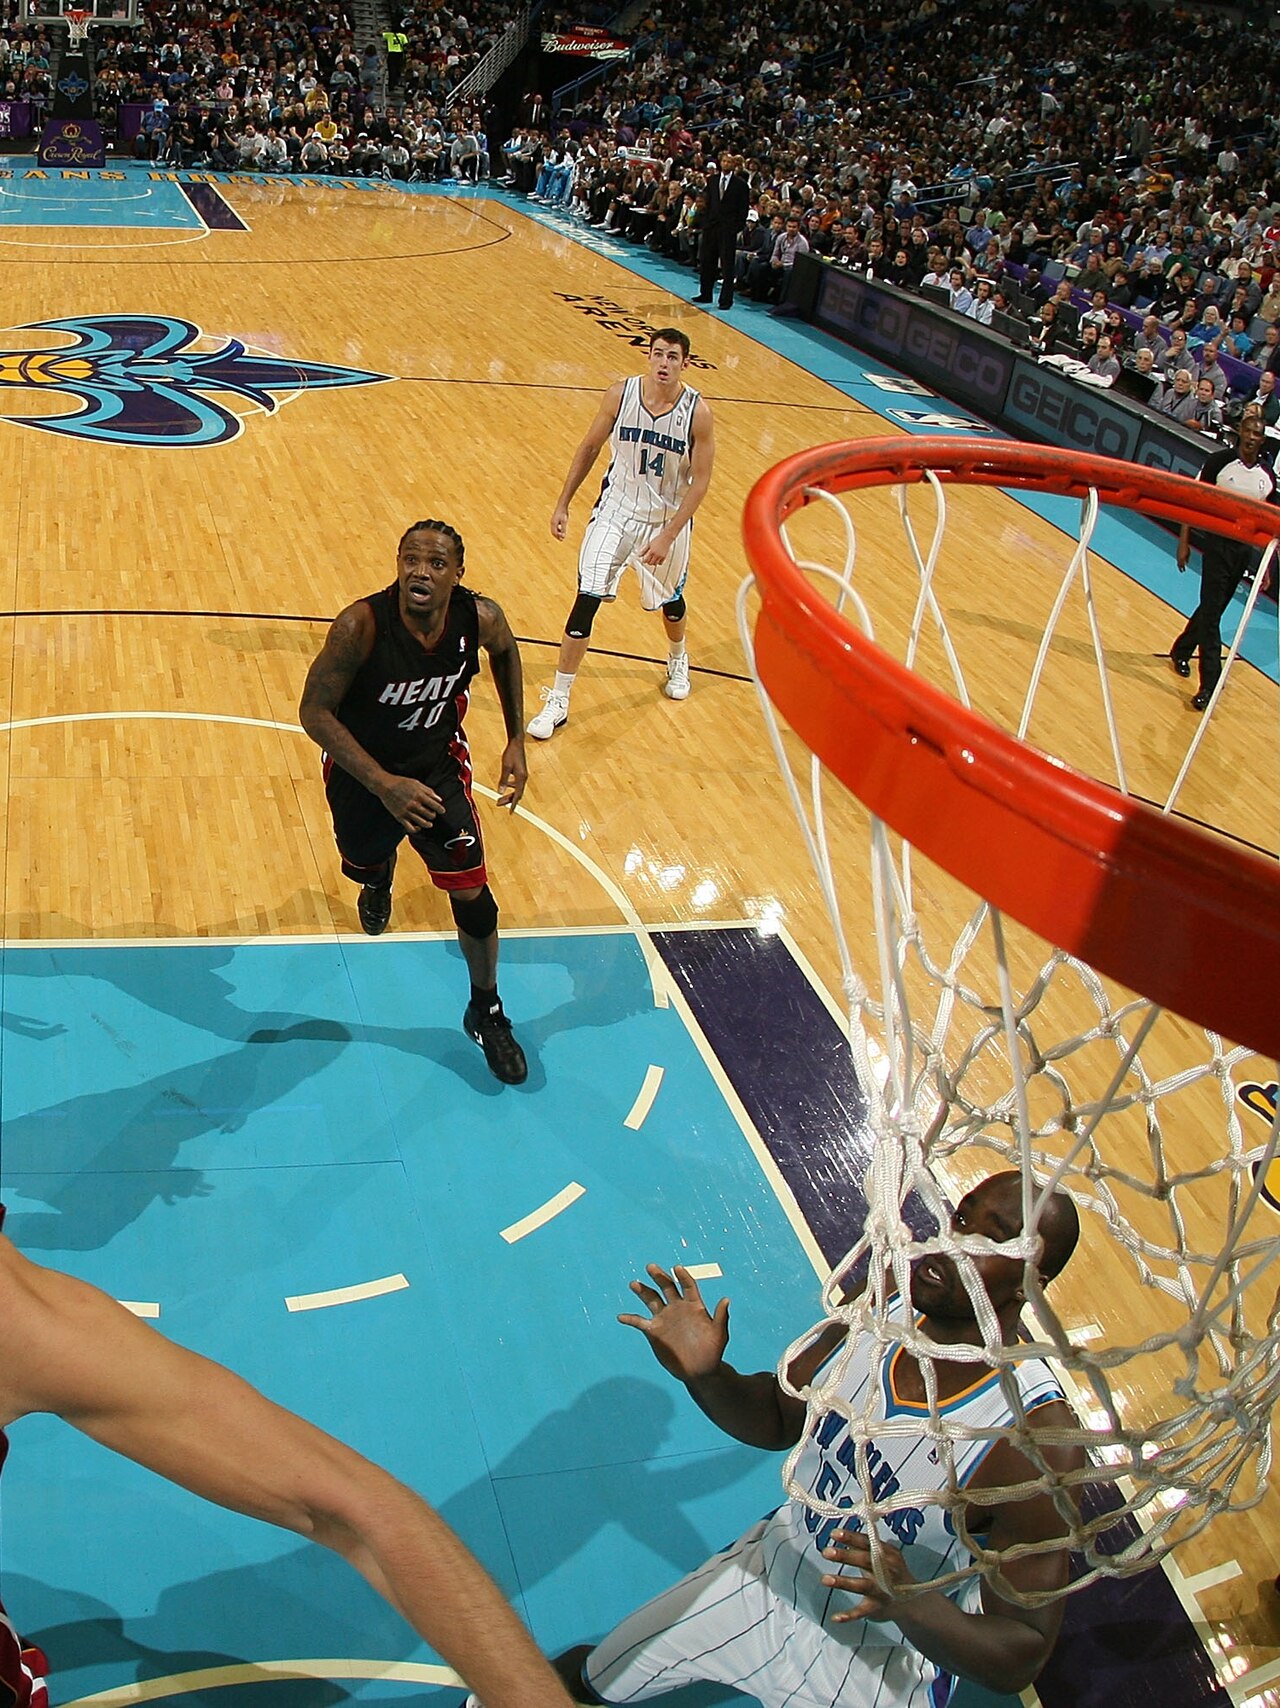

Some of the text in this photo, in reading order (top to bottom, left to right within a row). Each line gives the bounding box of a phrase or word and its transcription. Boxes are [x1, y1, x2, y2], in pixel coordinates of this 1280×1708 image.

[542, 39, 614, 53] Budweiser
[42, 146, 102, 163] Crown Royal
[148, 171, 402, 193] HORNETS
[552, 291, 651, 355] AREN
[907, 321, 1004, 395] GEICO
[1013, 373, 1128, 457] GEICO
[639, 448, 663, 477] 14
[378, 660, 467, 705] HEAT
[398, 701, 448, 731] 40
